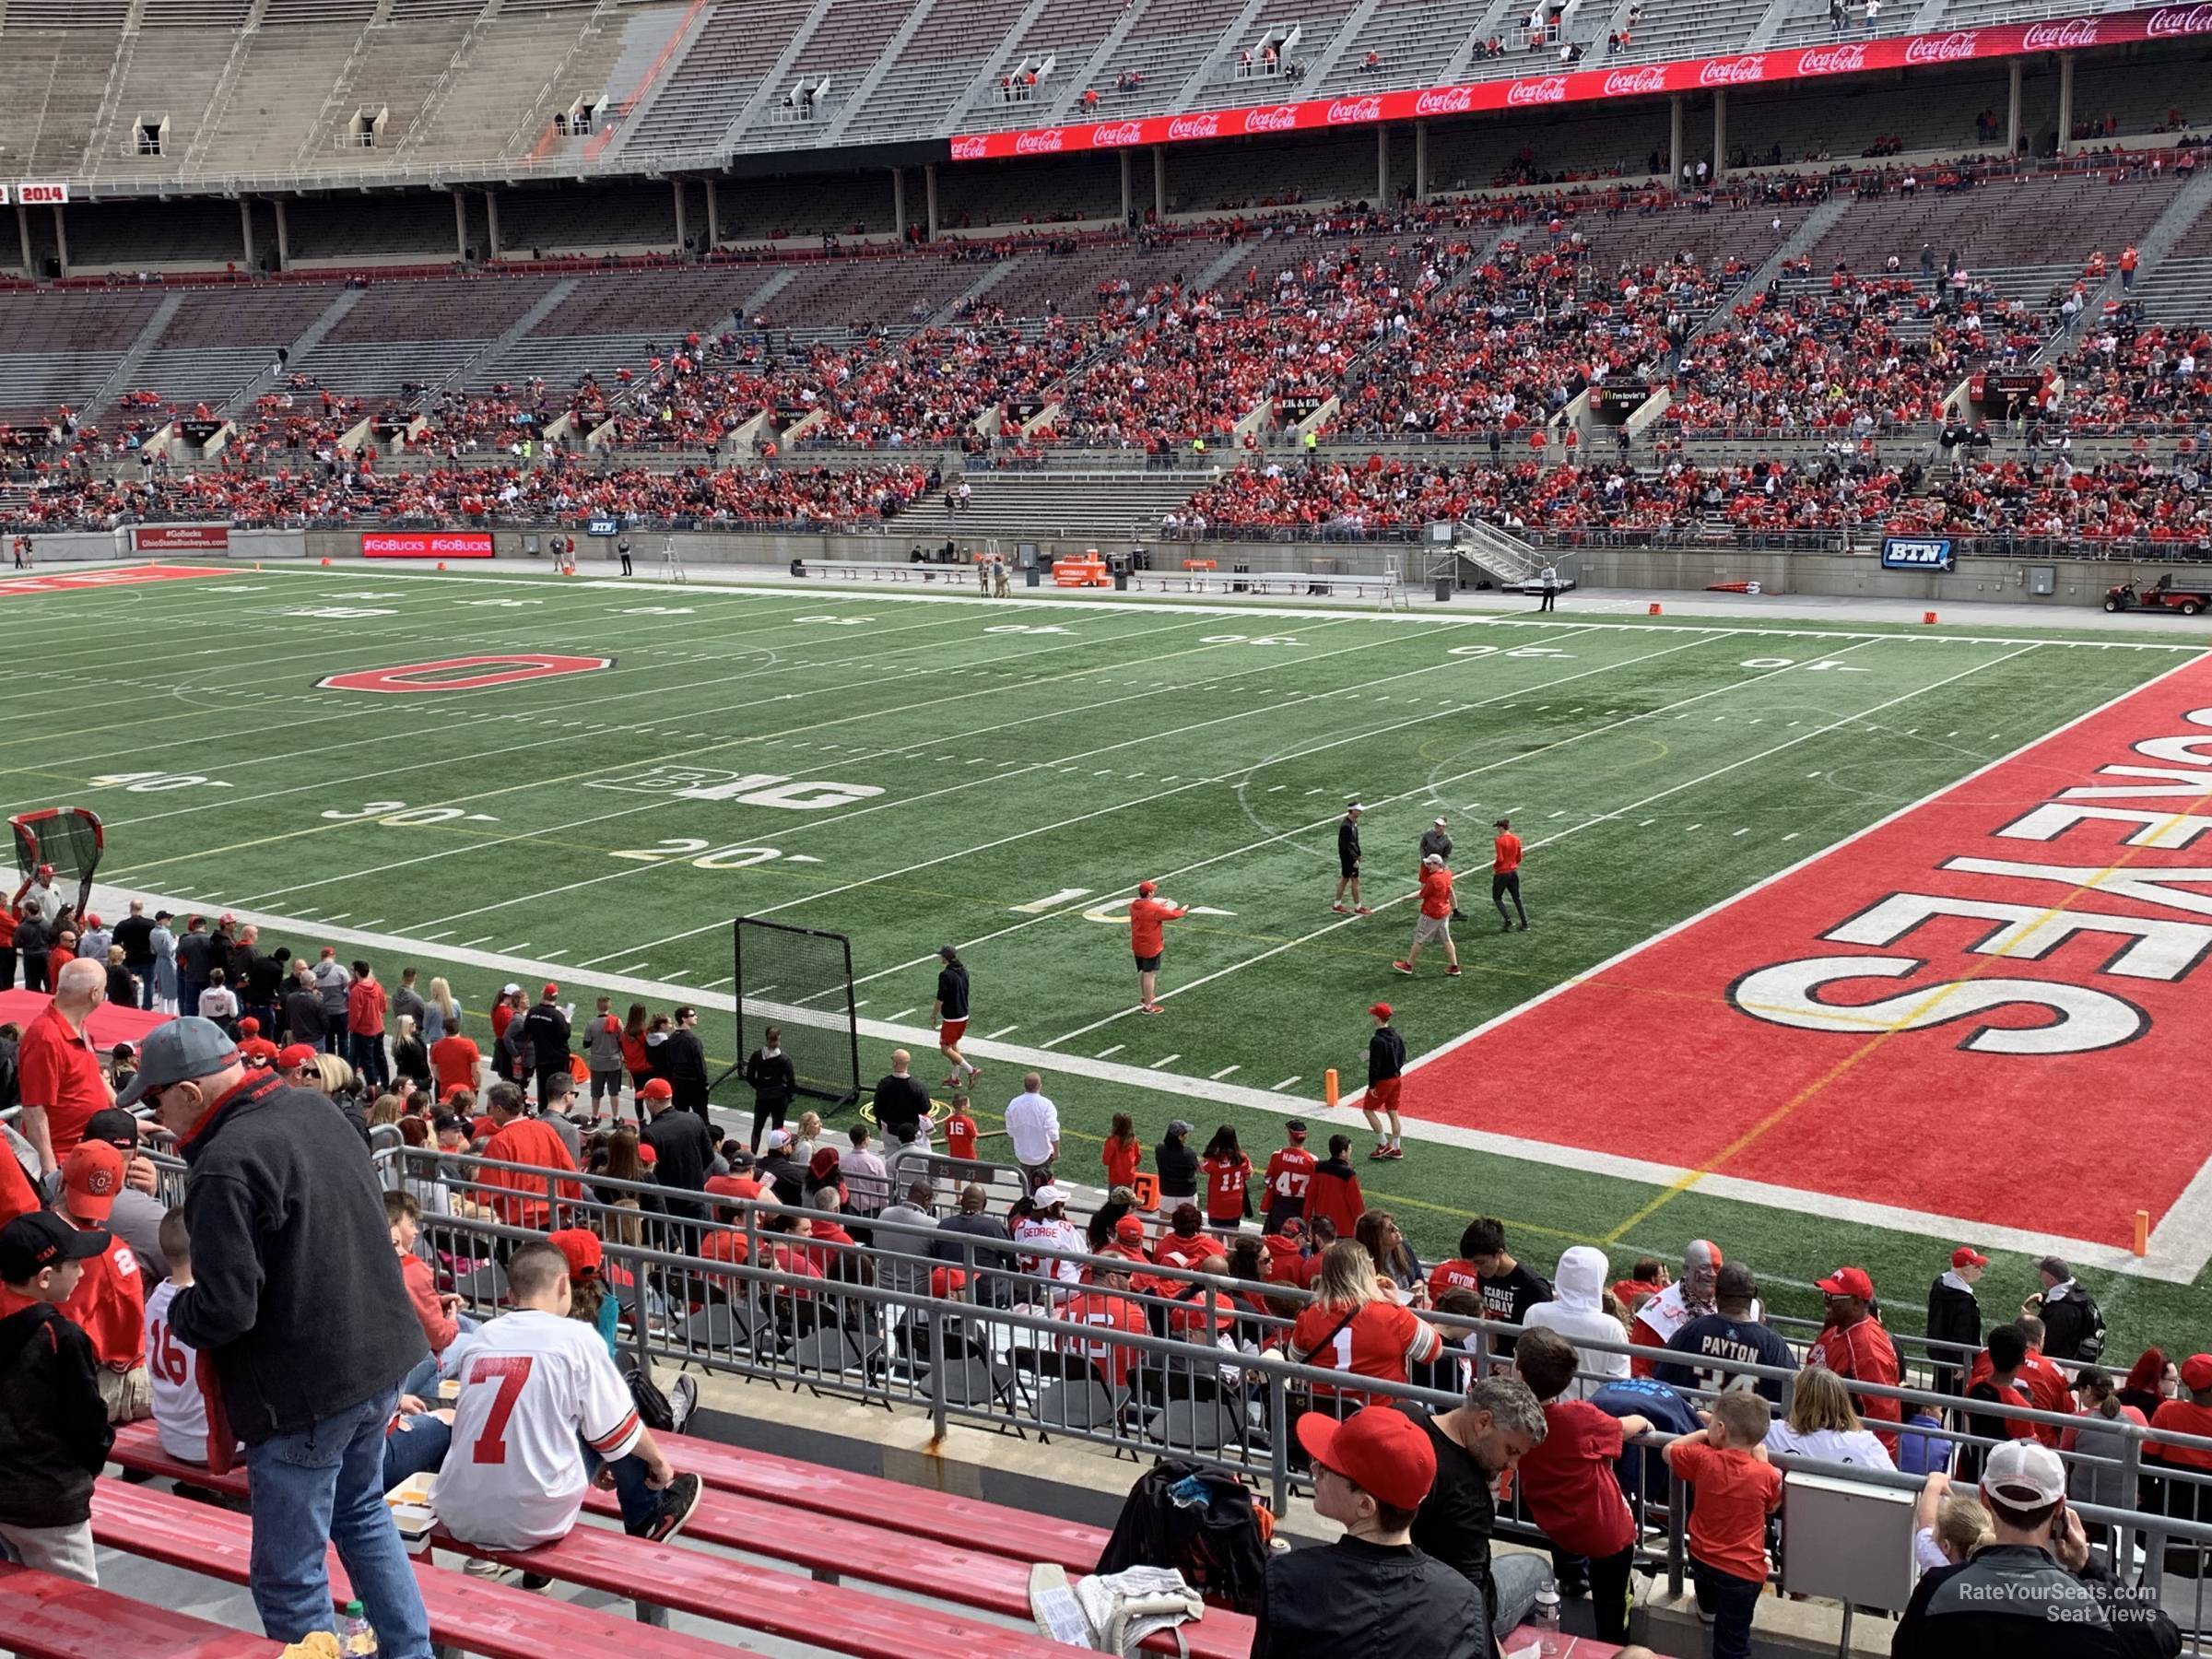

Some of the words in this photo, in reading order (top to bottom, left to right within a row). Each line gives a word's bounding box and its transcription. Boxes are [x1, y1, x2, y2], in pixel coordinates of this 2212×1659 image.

[23, 187, 63, 200] 2014
[1298, 398, 1304, 407] &
[1888, 542, 1940, 562] BTN
[87, 771, 207, 792] 40
[321, 801, 465, 826] 30
[608, 839, 782, 868] 20
[949, 1121, 964, 1135] 16
[1283, 1153, 1304, 1165] HAWK
[1135, 1177, 1151, 1206] G
[1220, 1171, 1241, 1192] 11
[1276, 1171, 1310, 1198] 47
[1024, 1226, 1058, 1239] GEORGE
[1448, 1272, 1475, 1288] PRYOR
[1484, 1286, 1514, 1301] SCARLET
[1489, 1299, 1514, 1314] GRAY
[151, 1319, 186, 1386] 16
[1333, 1327, 1352, 1371] 1
[1701, 1335, 1759, 1363] PAYTON
[469, 1357, 533, 1464] 7
